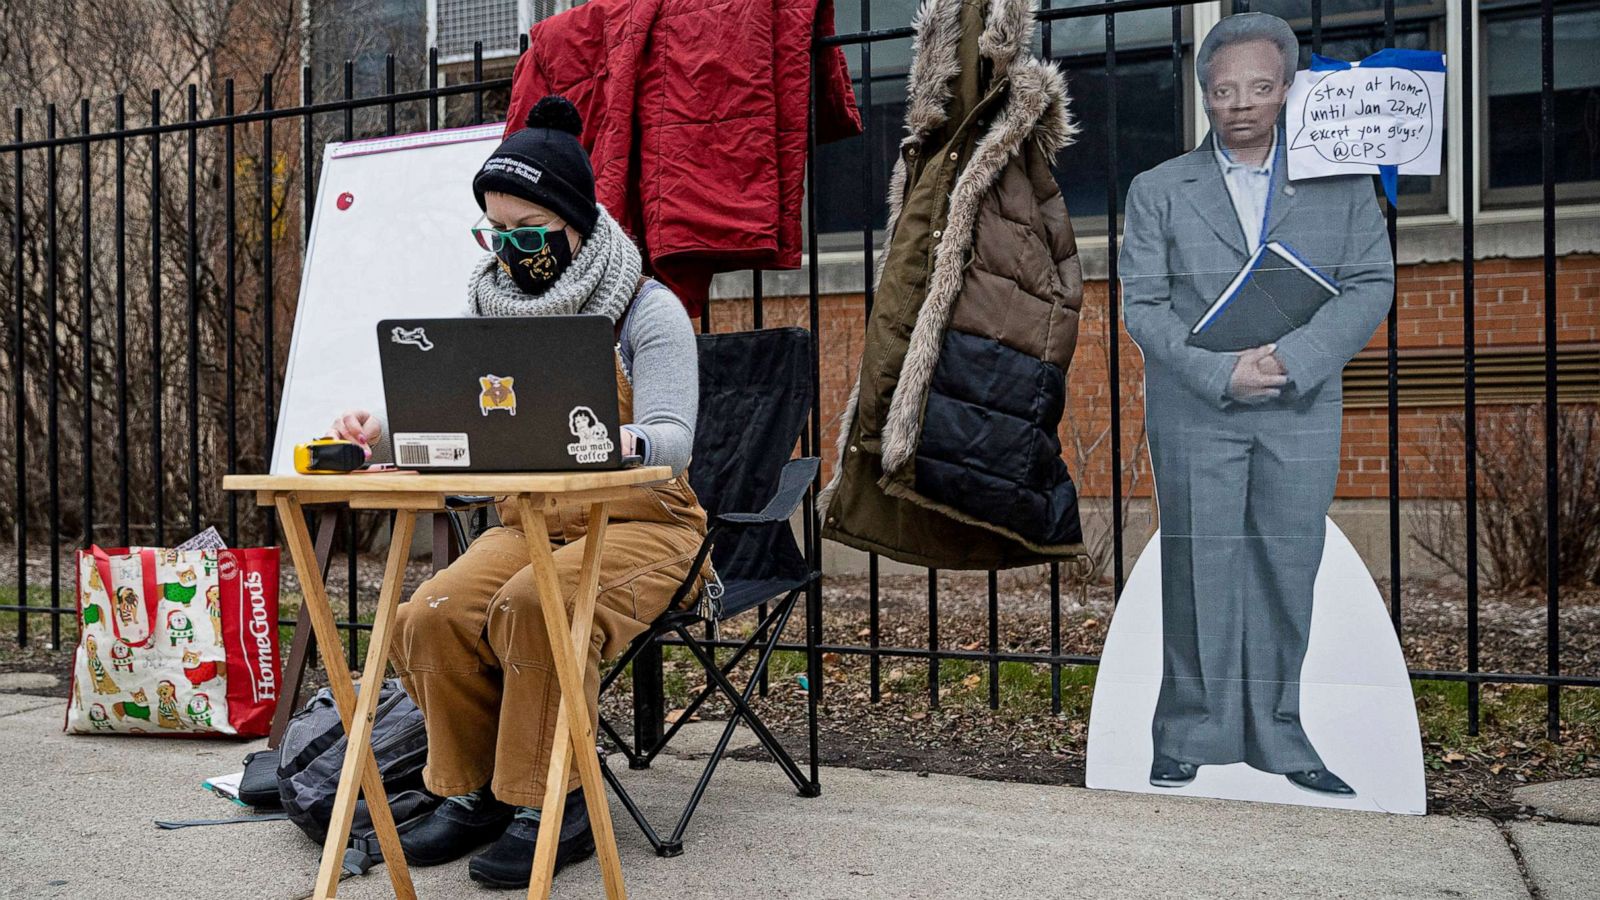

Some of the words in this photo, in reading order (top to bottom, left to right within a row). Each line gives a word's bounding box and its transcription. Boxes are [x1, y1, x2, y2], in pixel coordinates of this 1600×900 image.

[1314, 84, 1355, 102] stay
[1365, 76, 1382, 92] at
[1390, 76, 1424, 97] home
[1310, 103, 1346, 122] until
[1354, 99, 1381, 116] Jan
[1387, 125, 1424, 143] guys!
[1333, 141, 1387, 162] @CPS
[514, 167, 540, 184] School
[570, 445, 588, 453] new
[590, 440, 612, 450] math
[578, 451, 606, 461] coffee
[244, 571, 275, 701] HomeGoods
